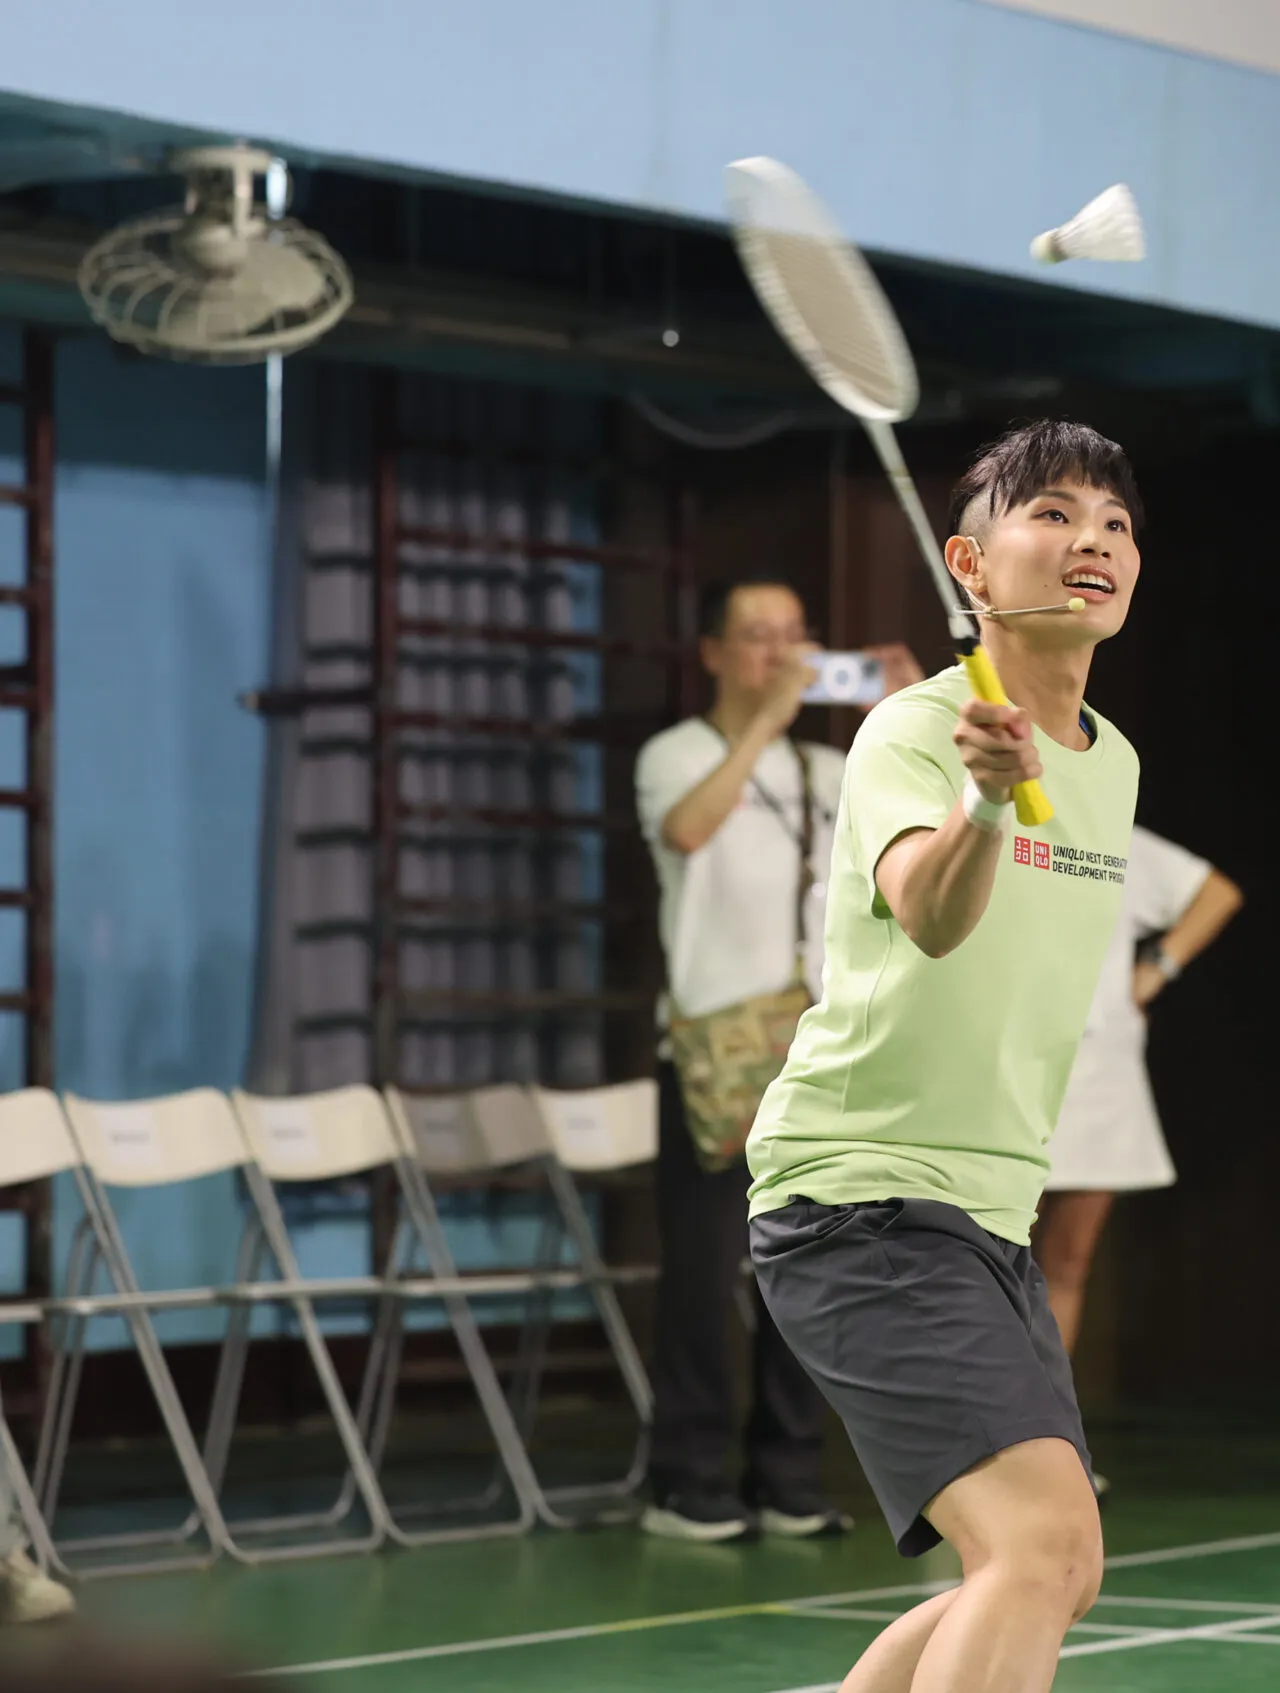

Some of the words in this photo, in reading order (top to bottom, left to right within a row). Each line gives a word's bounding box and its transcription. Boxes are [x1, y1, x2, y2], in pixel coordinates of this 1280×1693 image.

[1035, 844, 1048, 856] UNI
[1053, 845, 1085, 861] UNIQLO
[1086, 851, 1101, 864] NEXT
[1035, 855, 1049, 867] QLO
[1052, 860, 1107, 881] DEVELOPMENT
